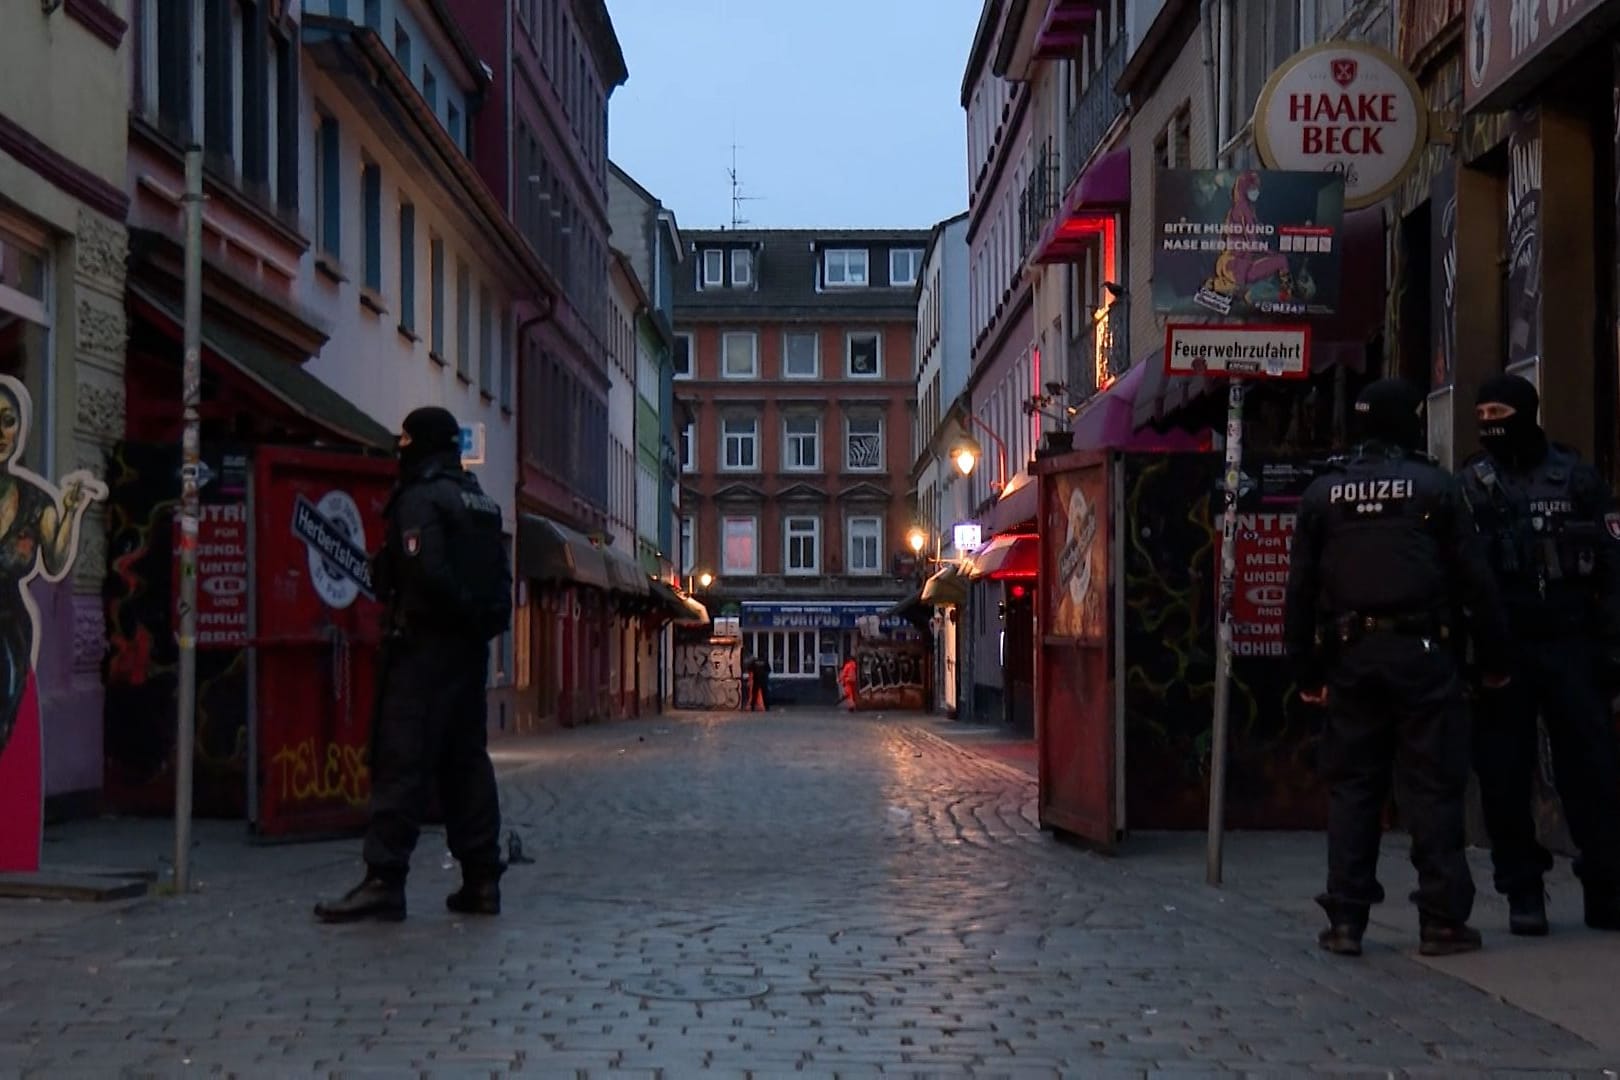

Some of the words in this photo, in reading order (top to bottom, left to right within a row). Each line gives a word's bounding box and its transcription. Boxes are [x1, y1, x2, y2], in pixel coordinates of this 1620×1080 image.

[1289, 93, 1398, 121] HAAKE
[1302, 127, 1384, 154] BECK
[1164, 222, 1202, 235] BITTE
[1203, 223, 1244, 235] MUND
[1244, 223, 1275, 235] UND
[1163, 239, 1199, 251] NASE
[1200, 239, 1270, 252] BEDECKEN
[1173, 340, 1301, 359] Feuerwehrzufahrt
[1329, 479, 1413, 504] POLIZEI
[1530, 501, 1573, 514] POLIZEI
[1245, 552, 1292, 566] MEN
